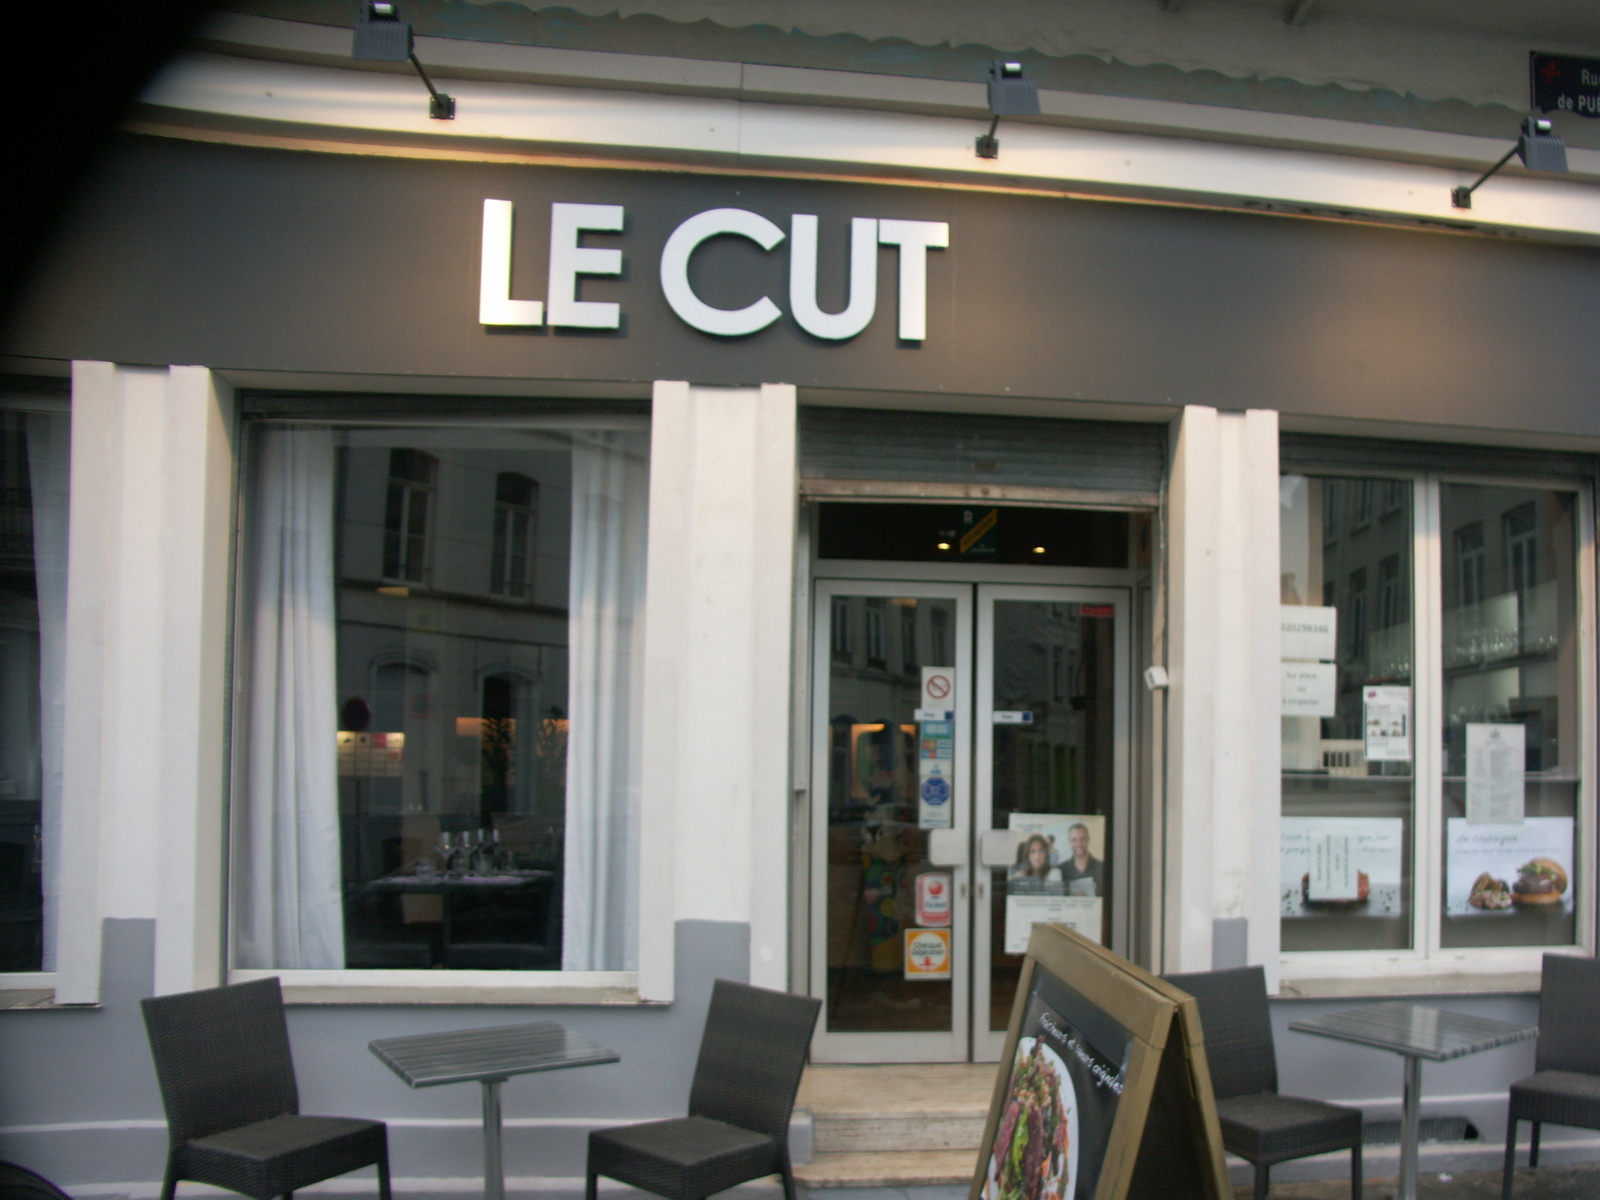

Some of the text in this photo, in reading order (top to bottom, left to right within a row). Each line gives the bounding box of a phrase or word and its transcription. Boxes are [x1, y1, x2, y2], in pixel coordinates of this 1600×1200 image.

[1557, 92, 1573, 110] de
[479, 198, 950, 341] LE CUT
